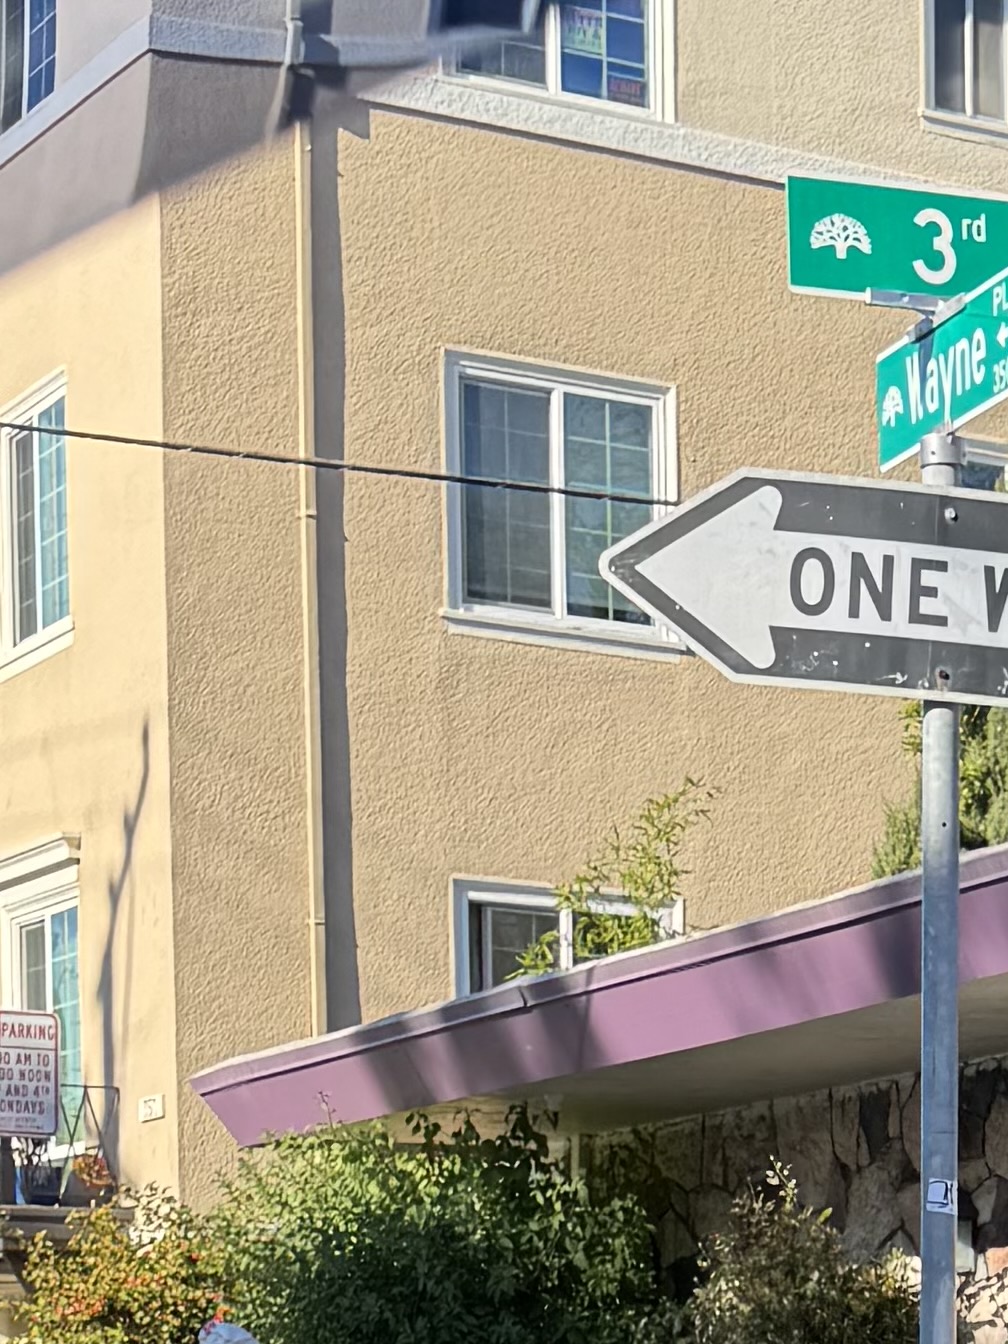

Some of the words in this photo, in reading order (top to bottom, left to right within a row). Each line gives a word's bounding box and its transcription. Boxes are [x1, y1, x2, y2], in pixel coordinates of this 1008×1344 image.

[912, 207, 987, 285] 3rd
[905, 327, 987, 425] Wayne
[789, 547, 949, 627] ONE
[1, 1021, 55, 1041] PARKING
[0, 1051, 10, 1065] 0
[16, 1052, 31, 1066] AM
[19, 1068, 51, 1082] NOON
[5, 1084, 29, 1097] AND
